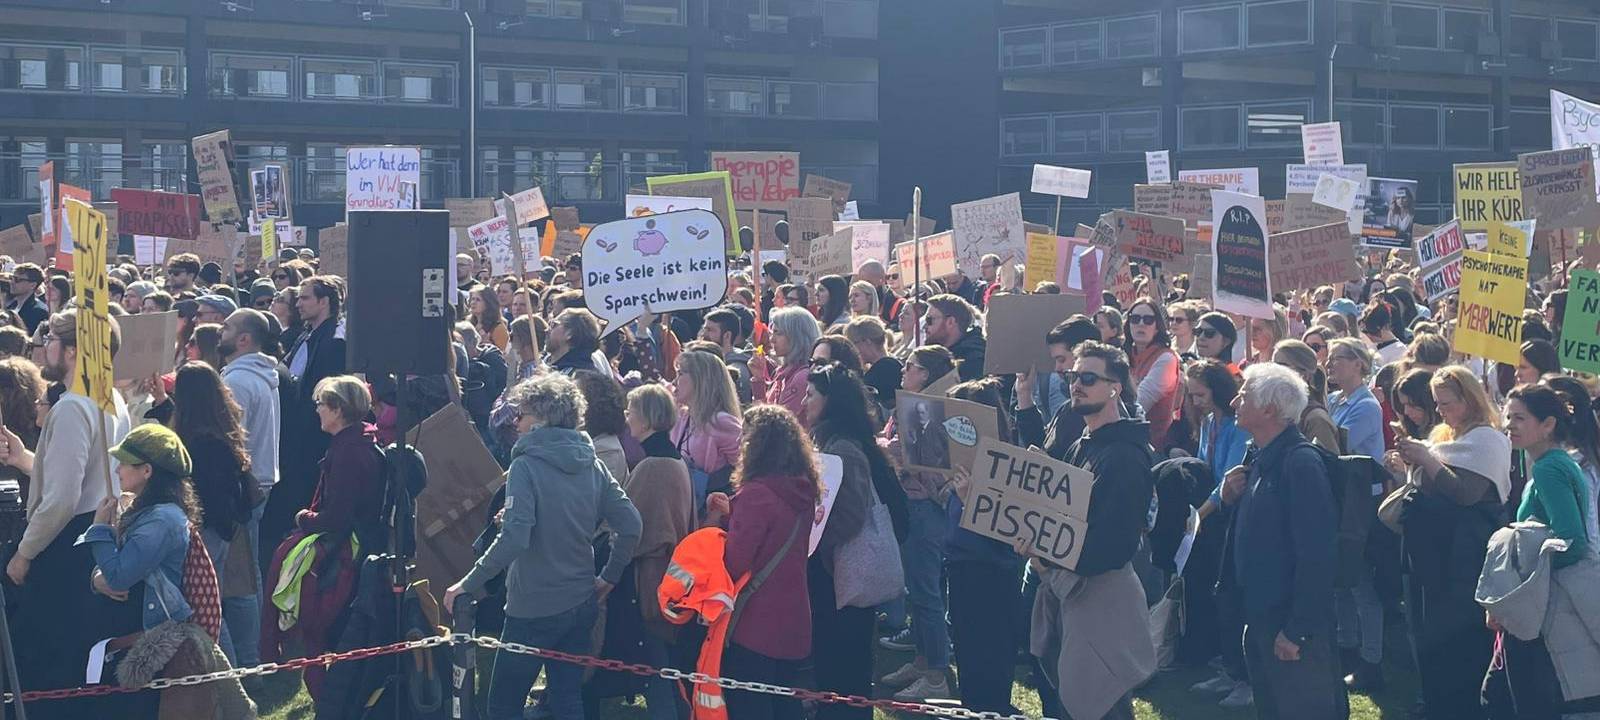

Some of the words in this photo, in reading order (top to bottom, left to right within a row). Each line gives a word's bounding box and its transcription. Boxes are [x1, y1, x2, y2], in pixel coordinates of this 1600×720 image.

[348, 152, 376, 170] Wer
[378, 150, 396, 171] hat
[397, 154, 419, 171] denn
[713, 154, 796, 179] Therapie
[359, 177, 373, 192] im
[1199, 172, 1244, 185] THERAPIE
[1458, 172, 1483, 190] WIR
[1488, 171, 1520, 190] HELF
[1537, 180, 1581, 195] VERPASST
[159, 196, 176, 210] AM
[1461, 198, 1487, 221] IHR
[1492, 195, 1522, 221] KÜR
[588, 271, 610, 287] Die
[615, 264, 654, 282] Seele
[663, 261, 682, 275] ist
[690, 257, 722, 272] kein
[1462, 256, 1525, 280] PSYCHOTHERAPIE
[604, 283, 708, 314] Sparschwein!
[1458, 301, 1522, 343] MEHRWERT
[986, 449, 1072, 506] THERA
[971, 493, 1075, 560] PISSED
